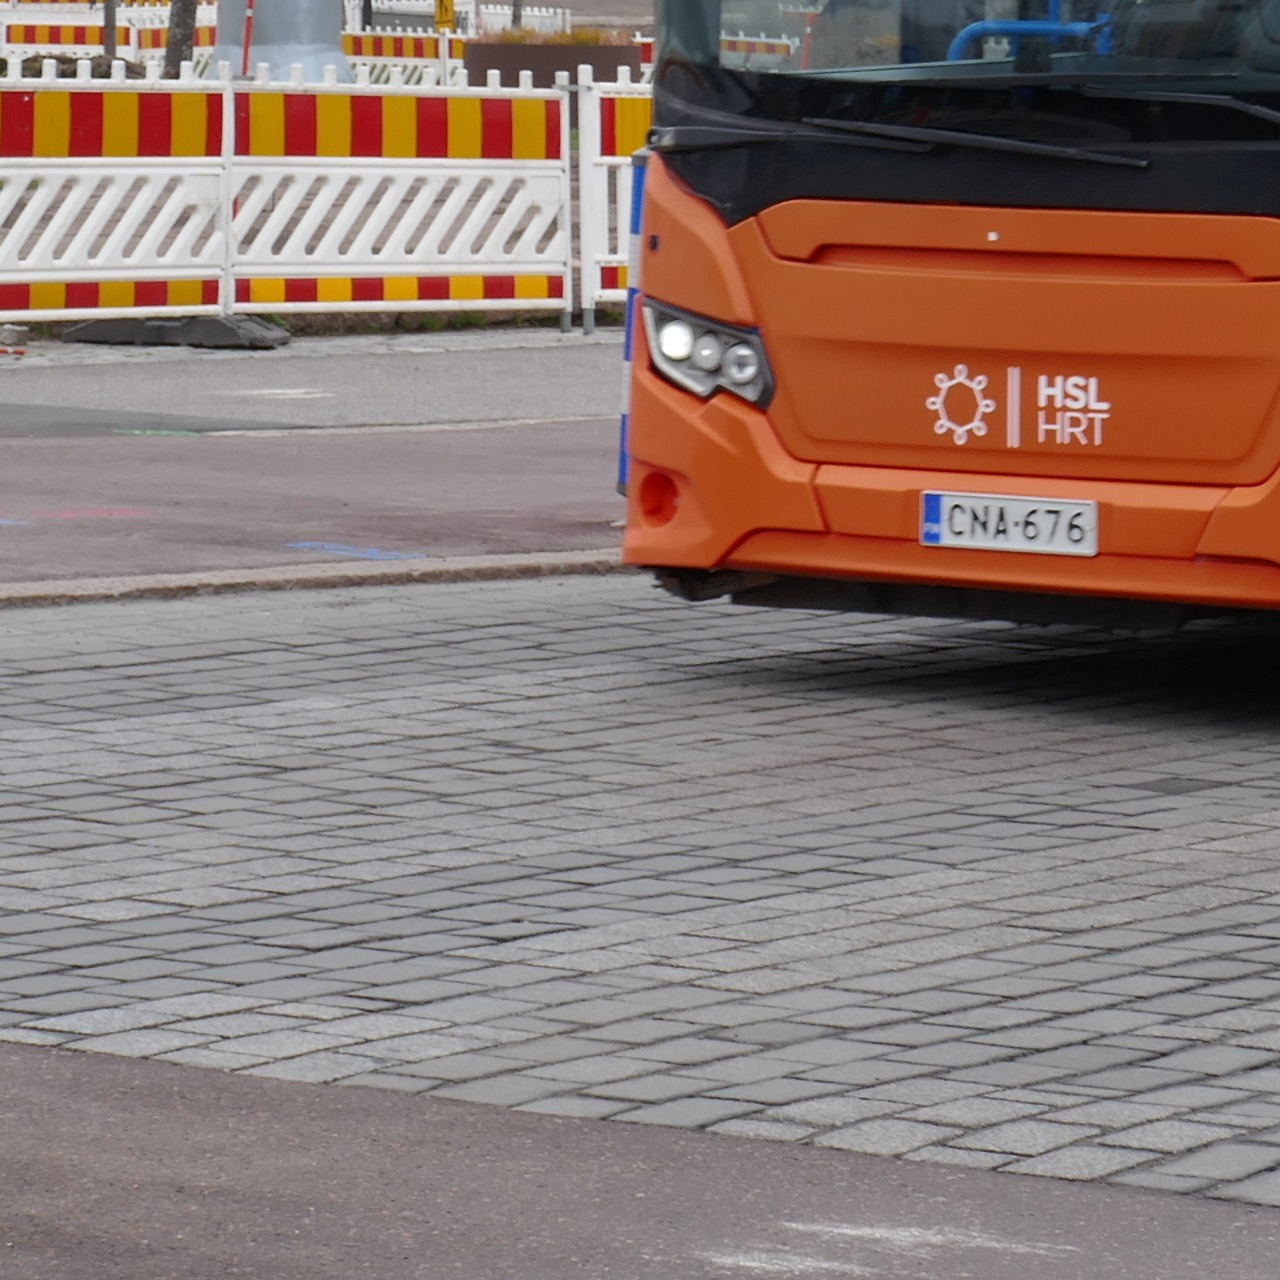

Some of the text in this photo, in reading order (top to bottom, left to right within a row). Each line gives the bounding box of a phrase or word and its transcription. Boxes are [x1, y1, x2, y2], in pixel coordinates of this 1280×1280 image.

[1037, 375, 1110, 410] HSL
[1037, 411, 1110, 447] HRT
[948, 503, 1085, 543] CNA-676
